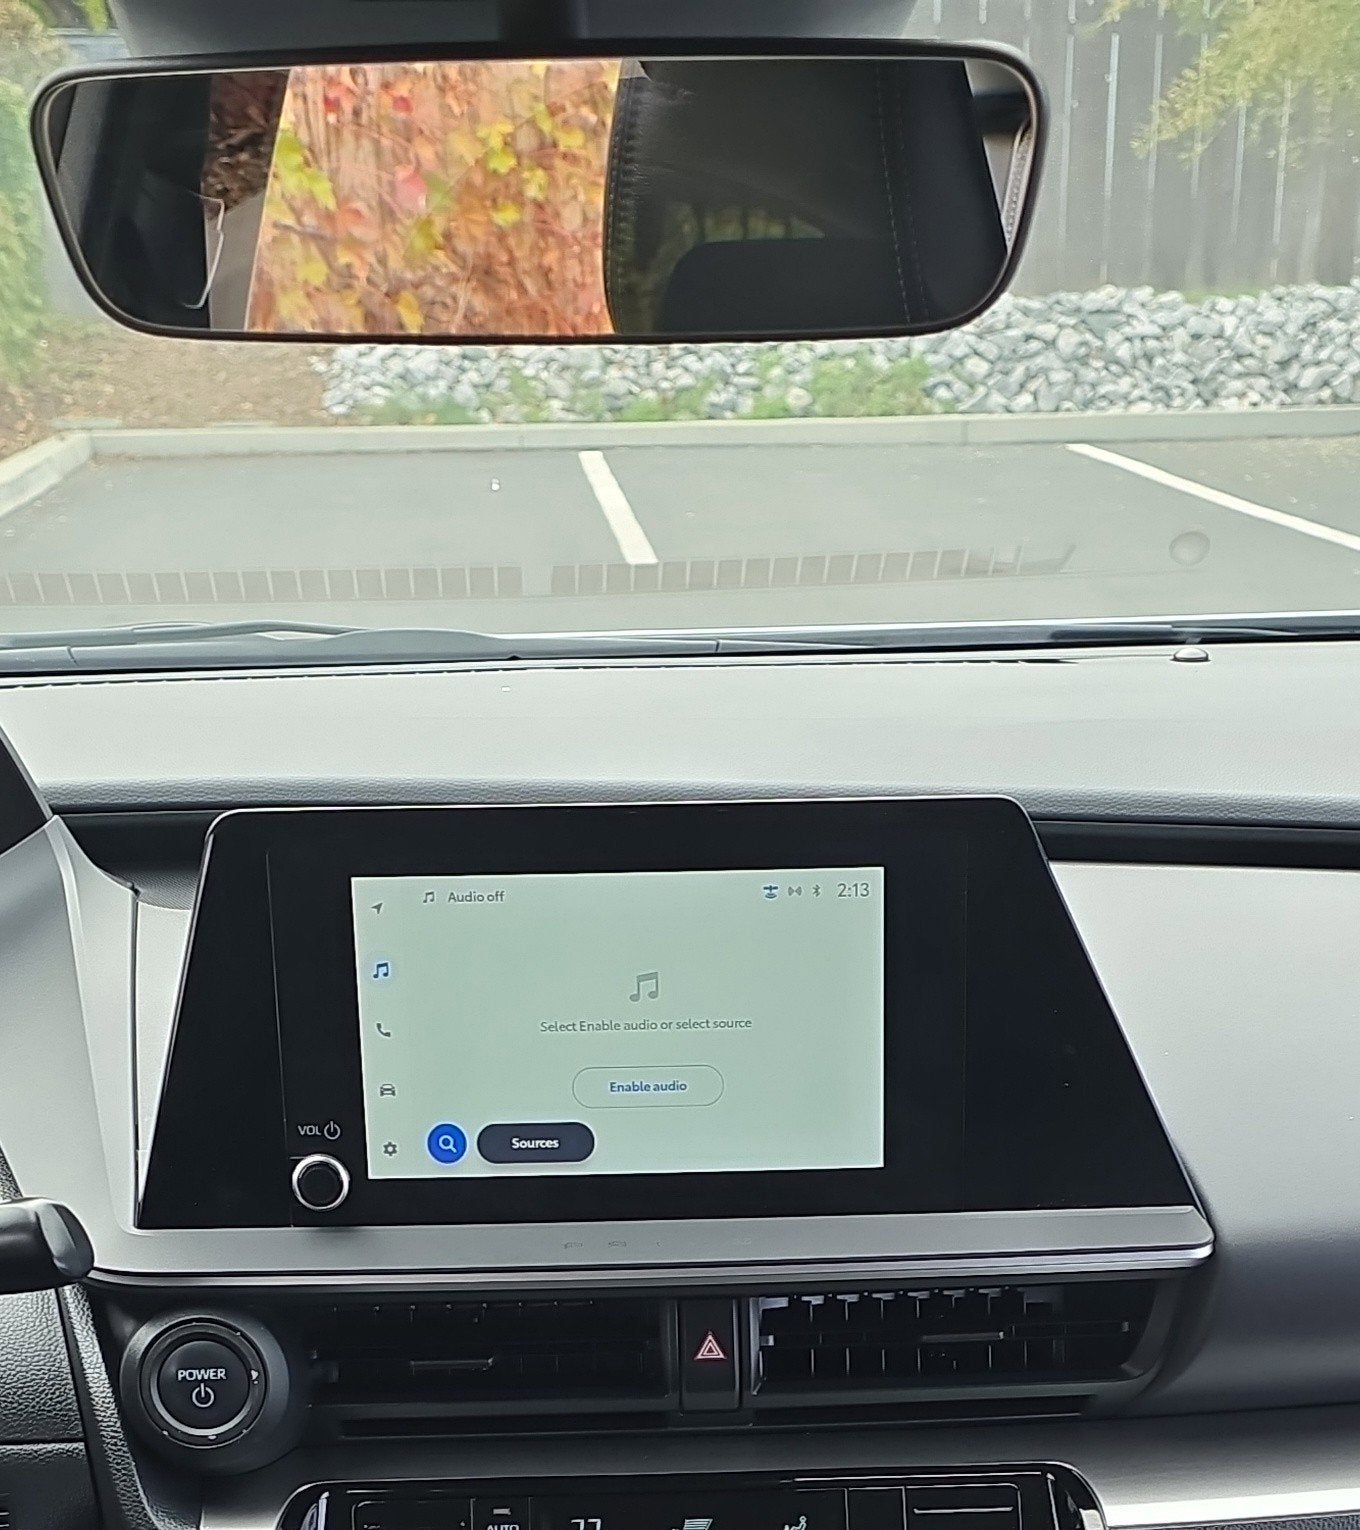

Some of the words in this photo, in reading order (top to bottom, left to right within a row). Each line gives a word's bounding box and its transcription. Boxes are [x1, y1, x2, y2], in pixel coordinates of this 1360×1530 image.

[837, 882, 870, 897] 2:13
[447, 891, 485, 903] Audio
[487, 890, 506, 902] off
[540, 1021, 578, 1032] Select
[579, 1020, 621, 1031] Enable
[623, 1019, 658, 1031] audio
[660, 1020, 673, 1030] or
[675, 1018, 711, 1030] select
[713, 1018, 752, 1029] source
[610, 1081, 651, 1093] Enable
[653, 1080, 687, 1092] audio
[297, 1125, 322, 1136] VOL
[511, 1137, 559, 1149] Sources
[177, 1368, 227, 1381] POWER
